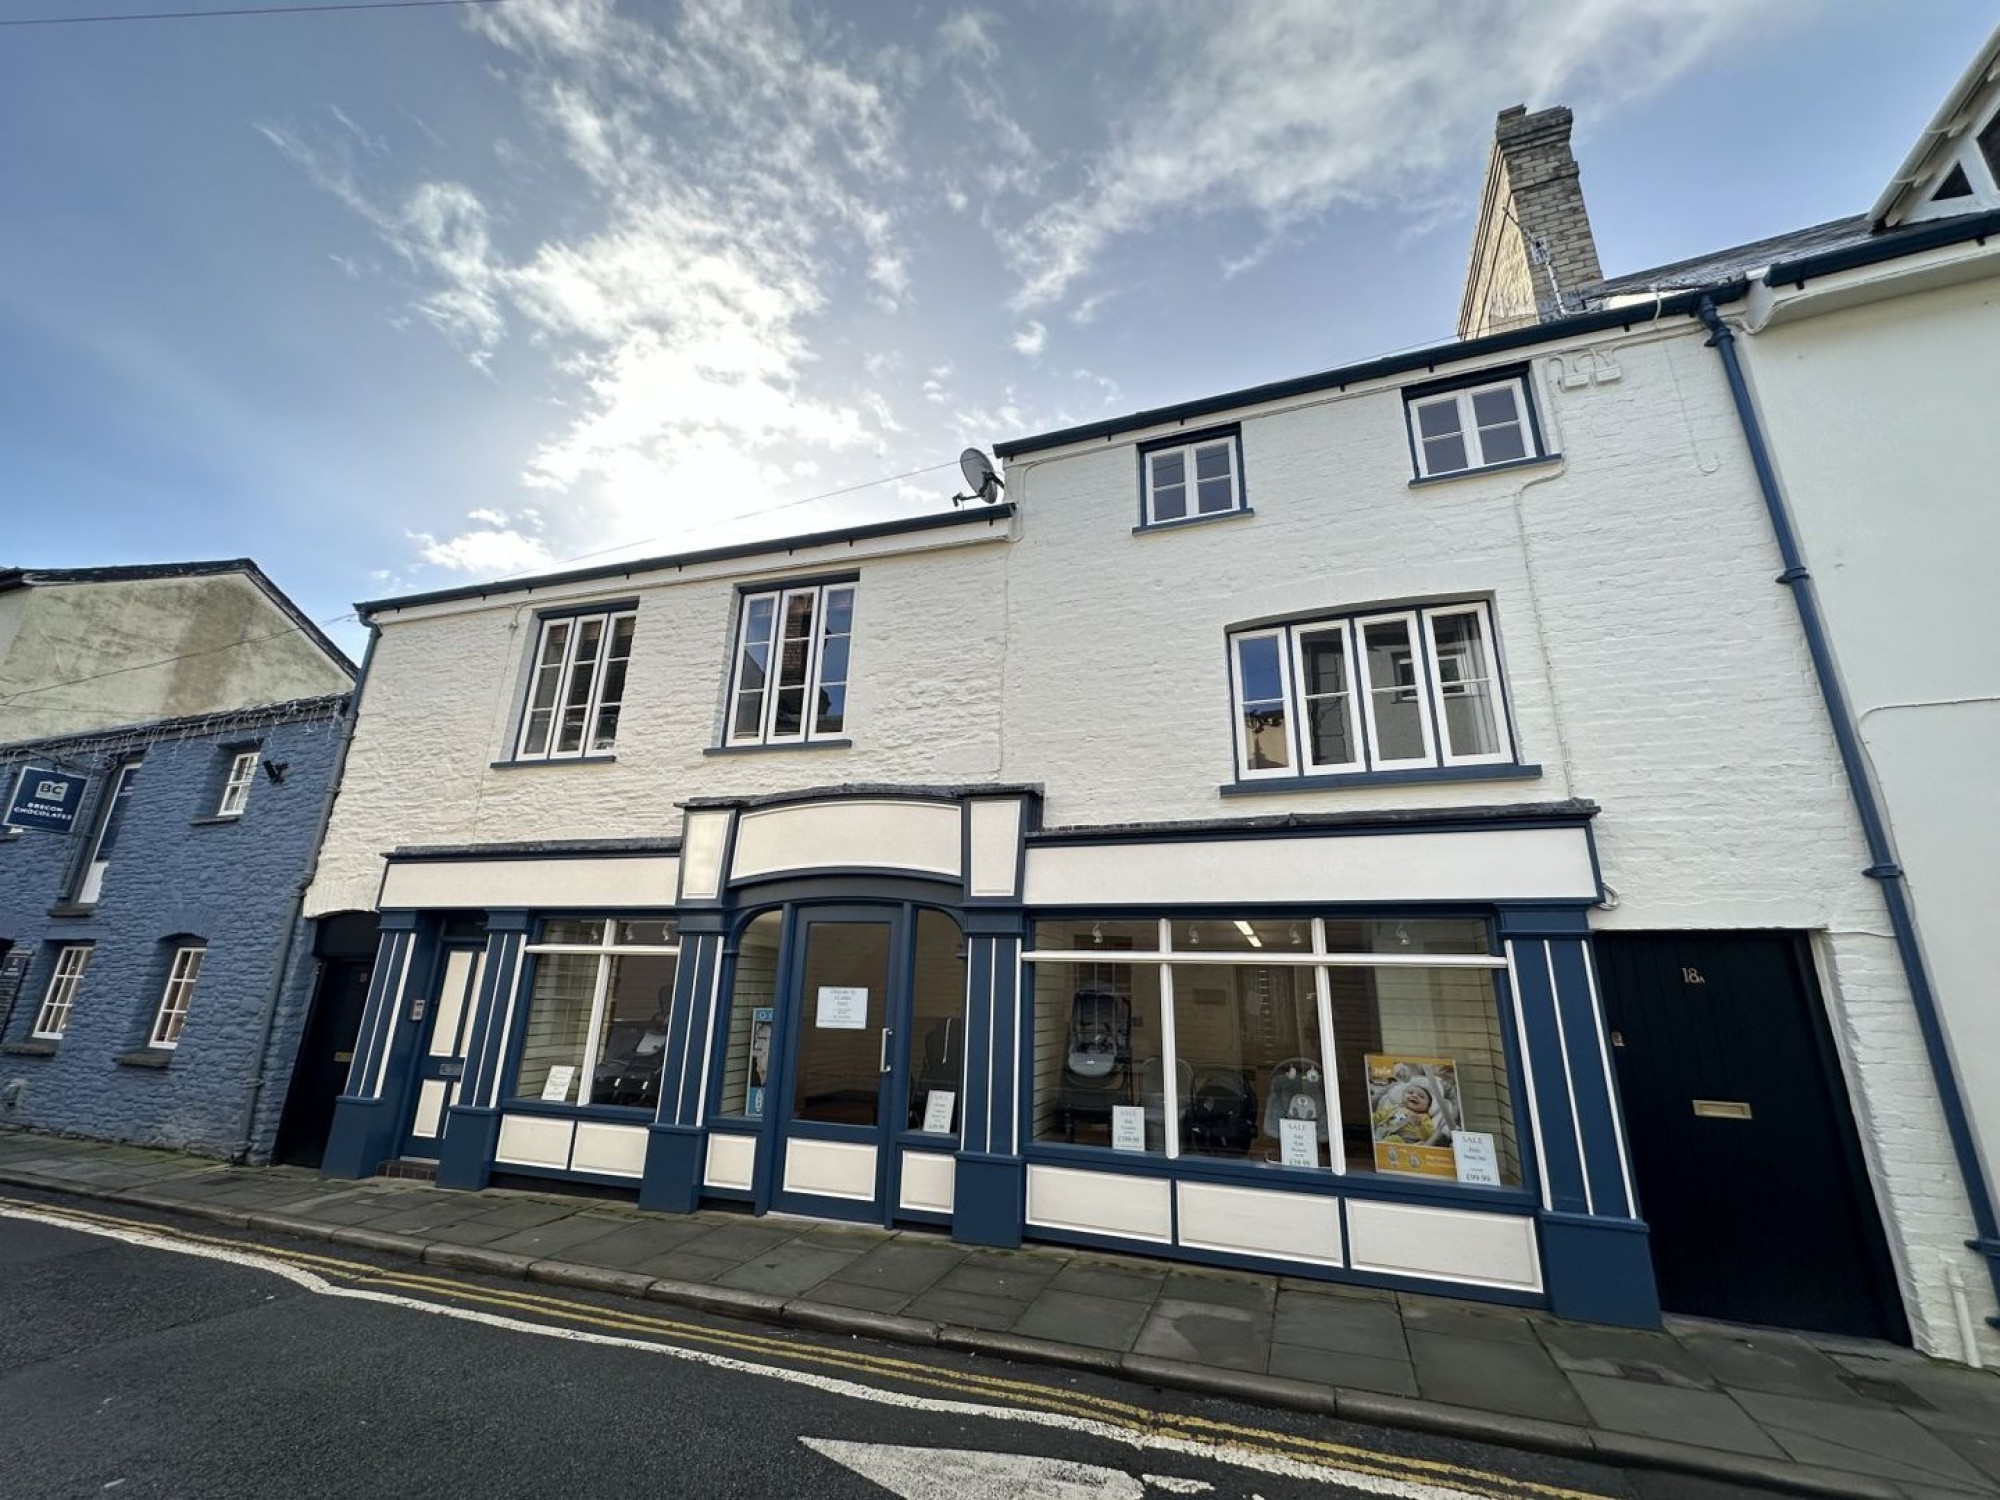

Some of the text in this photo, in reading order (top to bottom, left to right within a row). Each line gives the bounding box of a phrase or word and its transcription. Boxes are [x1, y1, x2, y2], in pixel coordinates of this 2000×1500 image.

[40, 782, 64, 795] BC
[27, 802, 63, 812] BRECON
[13, 806, 72, 820] CHOCOLATES
[1462, 1135, 1482, 1144] SALE
